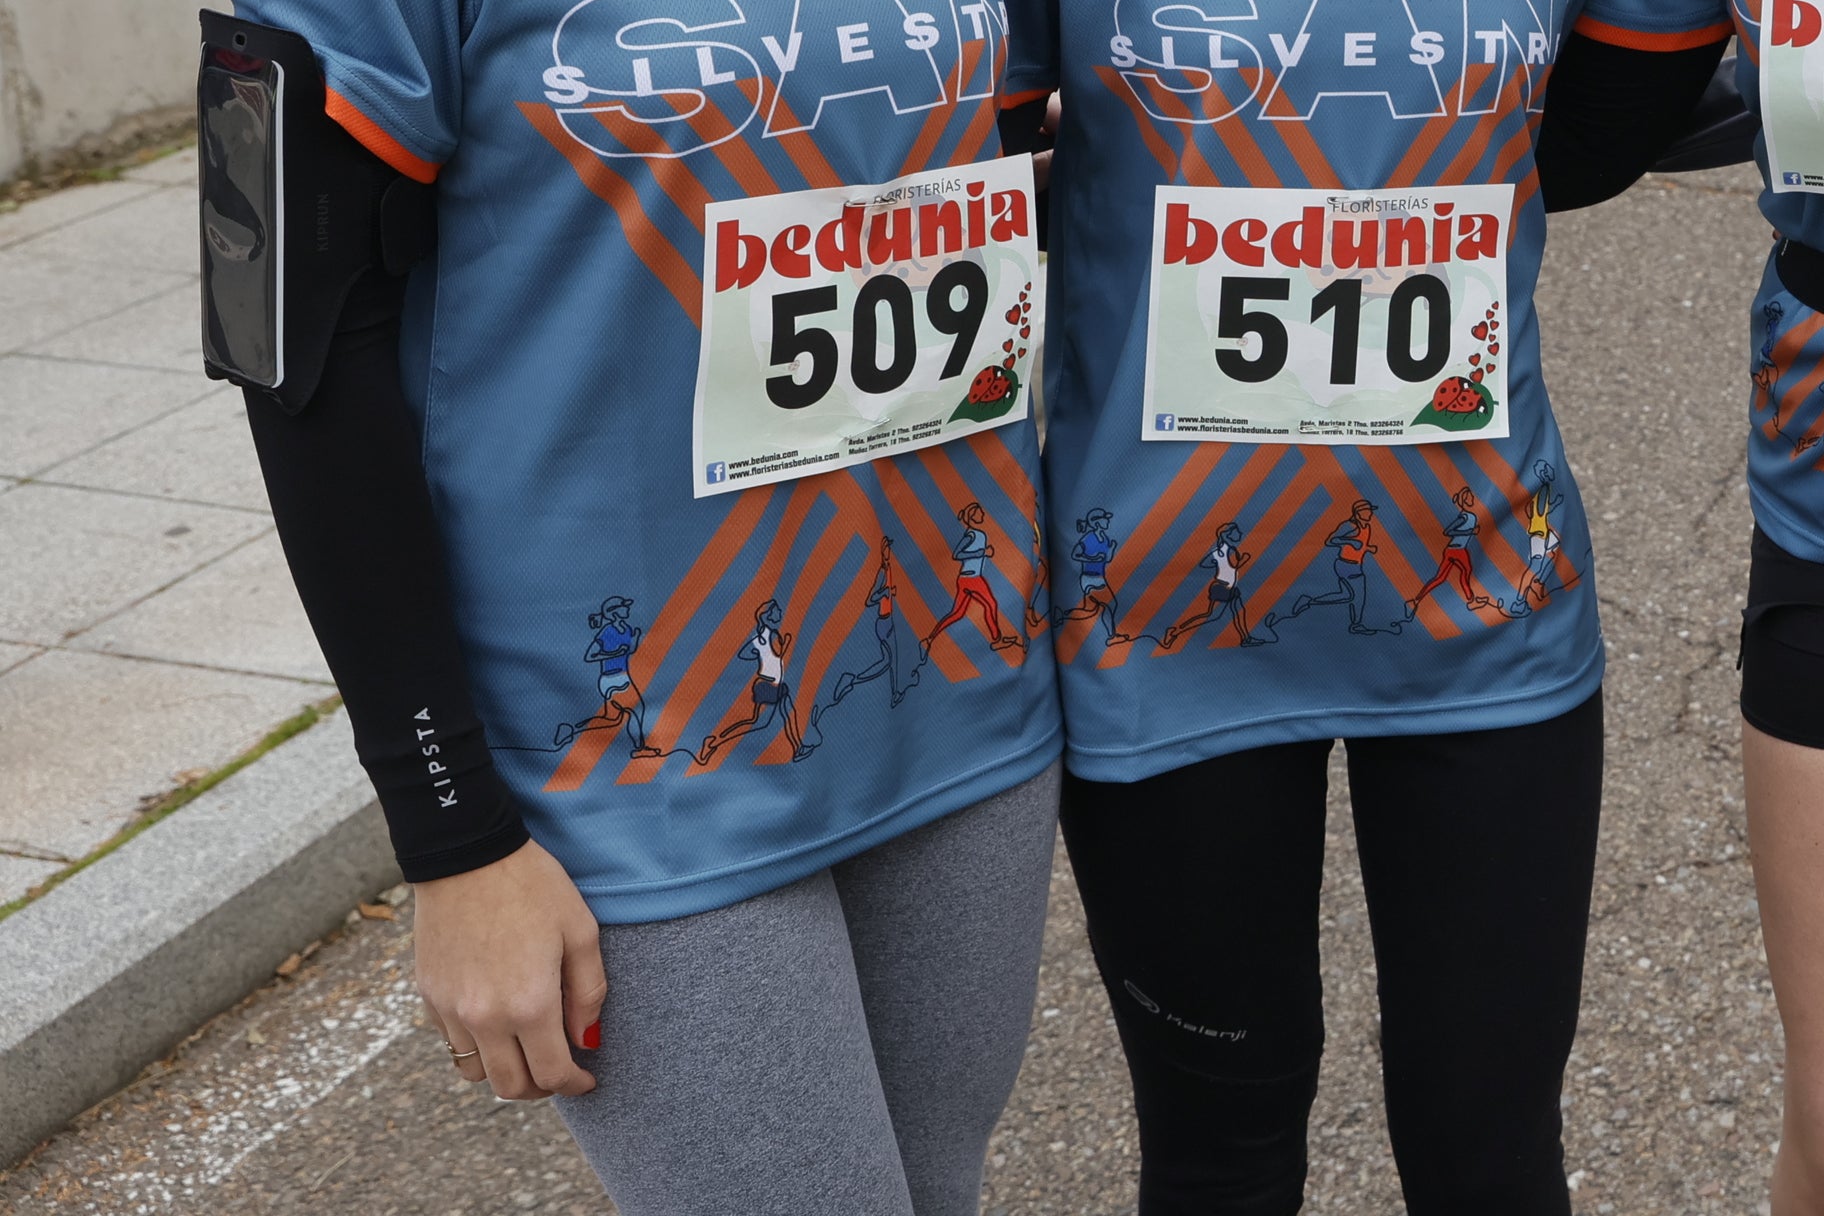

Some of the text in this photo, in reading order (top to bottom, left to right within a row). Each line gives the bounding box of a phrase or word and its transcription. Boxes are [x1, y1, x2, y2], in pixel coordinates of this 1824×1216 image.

[1110, 30, 1561, 68] SILVESTR
[1332, 195, 1430, 214] FLORISTERÍAS
[715, 181, 1029, 293] bedunia
[1163, 202, 1500, 269] bedunia
[766, 260, 989, 410] 509
[1215, 274, 1452, 385] 510
[1177, 415, 1249, 426] www.bedunia.com
[1177, 424, 1290, 435] www.floristeriasbedunia.com
[728, 450, 798, 470] www.bedunia.com
[728, 451, 840, 480] www.floristeriasbedunia.com
[413, 707, 458, 808] KIPSTA
